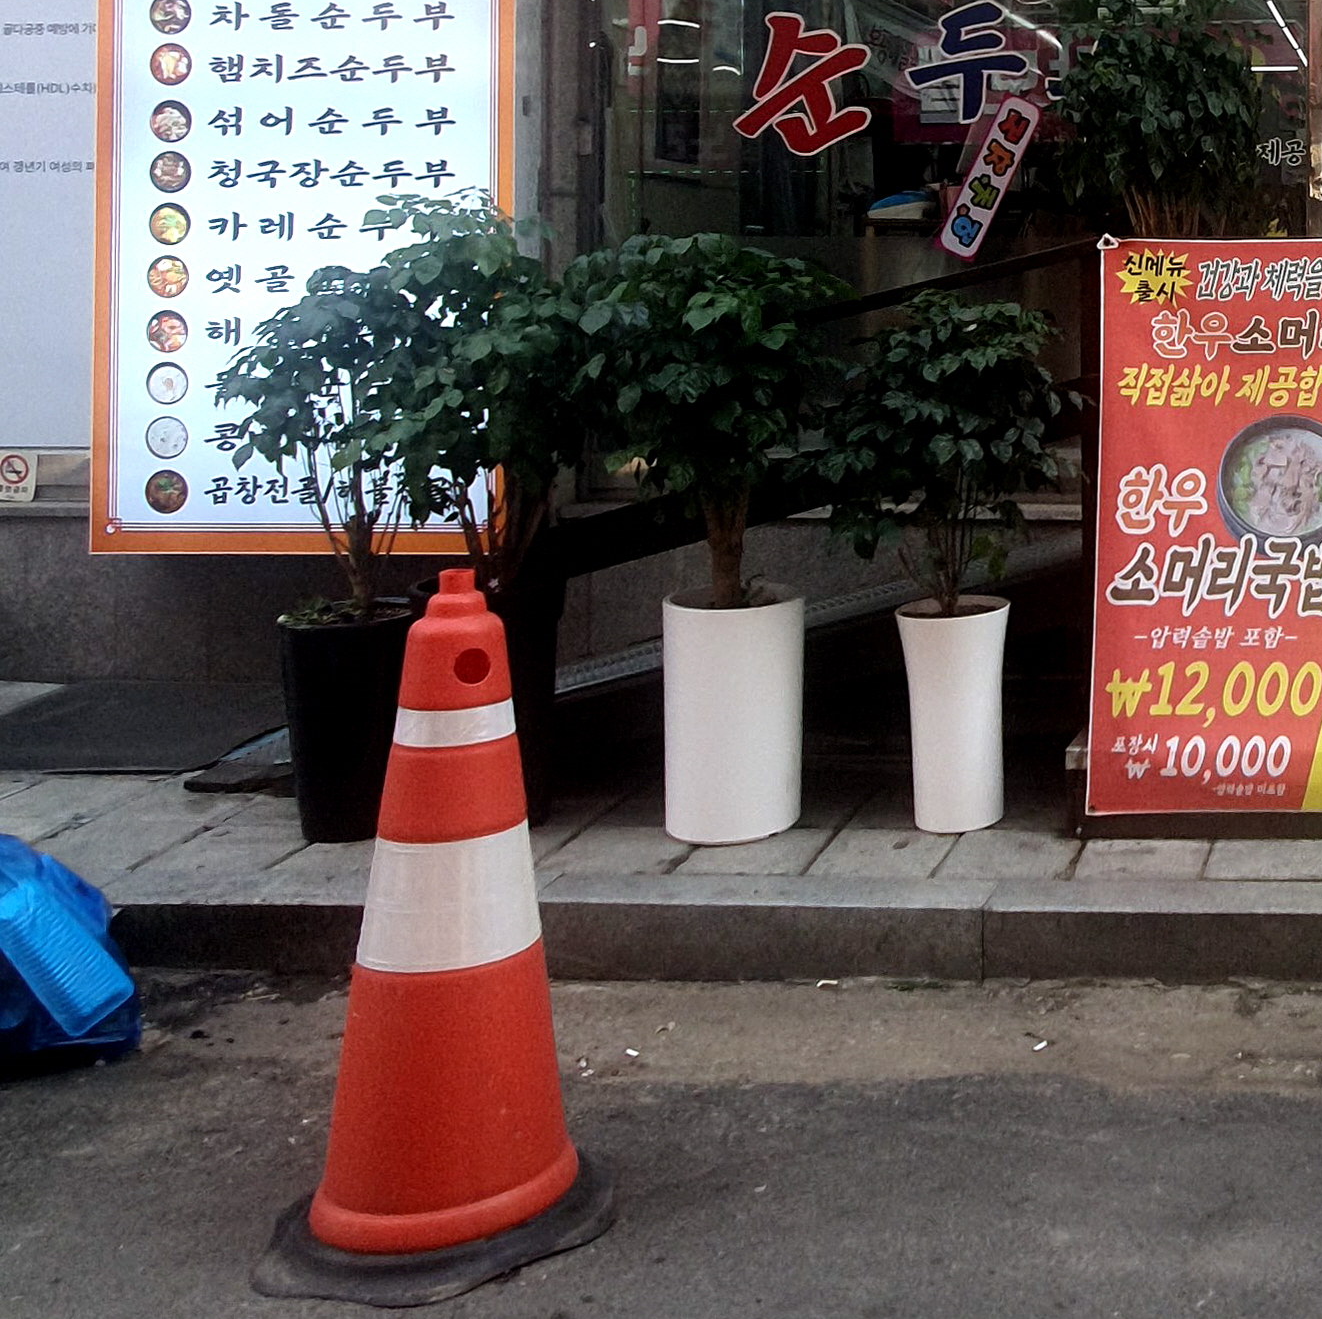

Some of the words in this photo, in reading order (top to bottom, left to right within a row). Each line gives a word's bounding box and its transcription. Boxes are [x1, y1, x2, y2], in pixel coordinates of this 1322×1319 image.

[209, 2, 456, 32] 차돌순두부
[208, 54, 456, 84] 햄치즈순두부
[733, 1, 1067, 156] 순두
[1255, 136, 1306, 166] 제공
[206, 159, 456, 188] 청국장순두부
[1123, 254, 1188, 277] 신메뉴
[1196, 258, 1263, 301] 건강과
[1133, 280, 1177, 303] 출시
[1117, 363, 1231, 407] 직접삶아
[1116, 463, 1208, 536] 한우
[1111, 733, 1158, 754] 포장시
